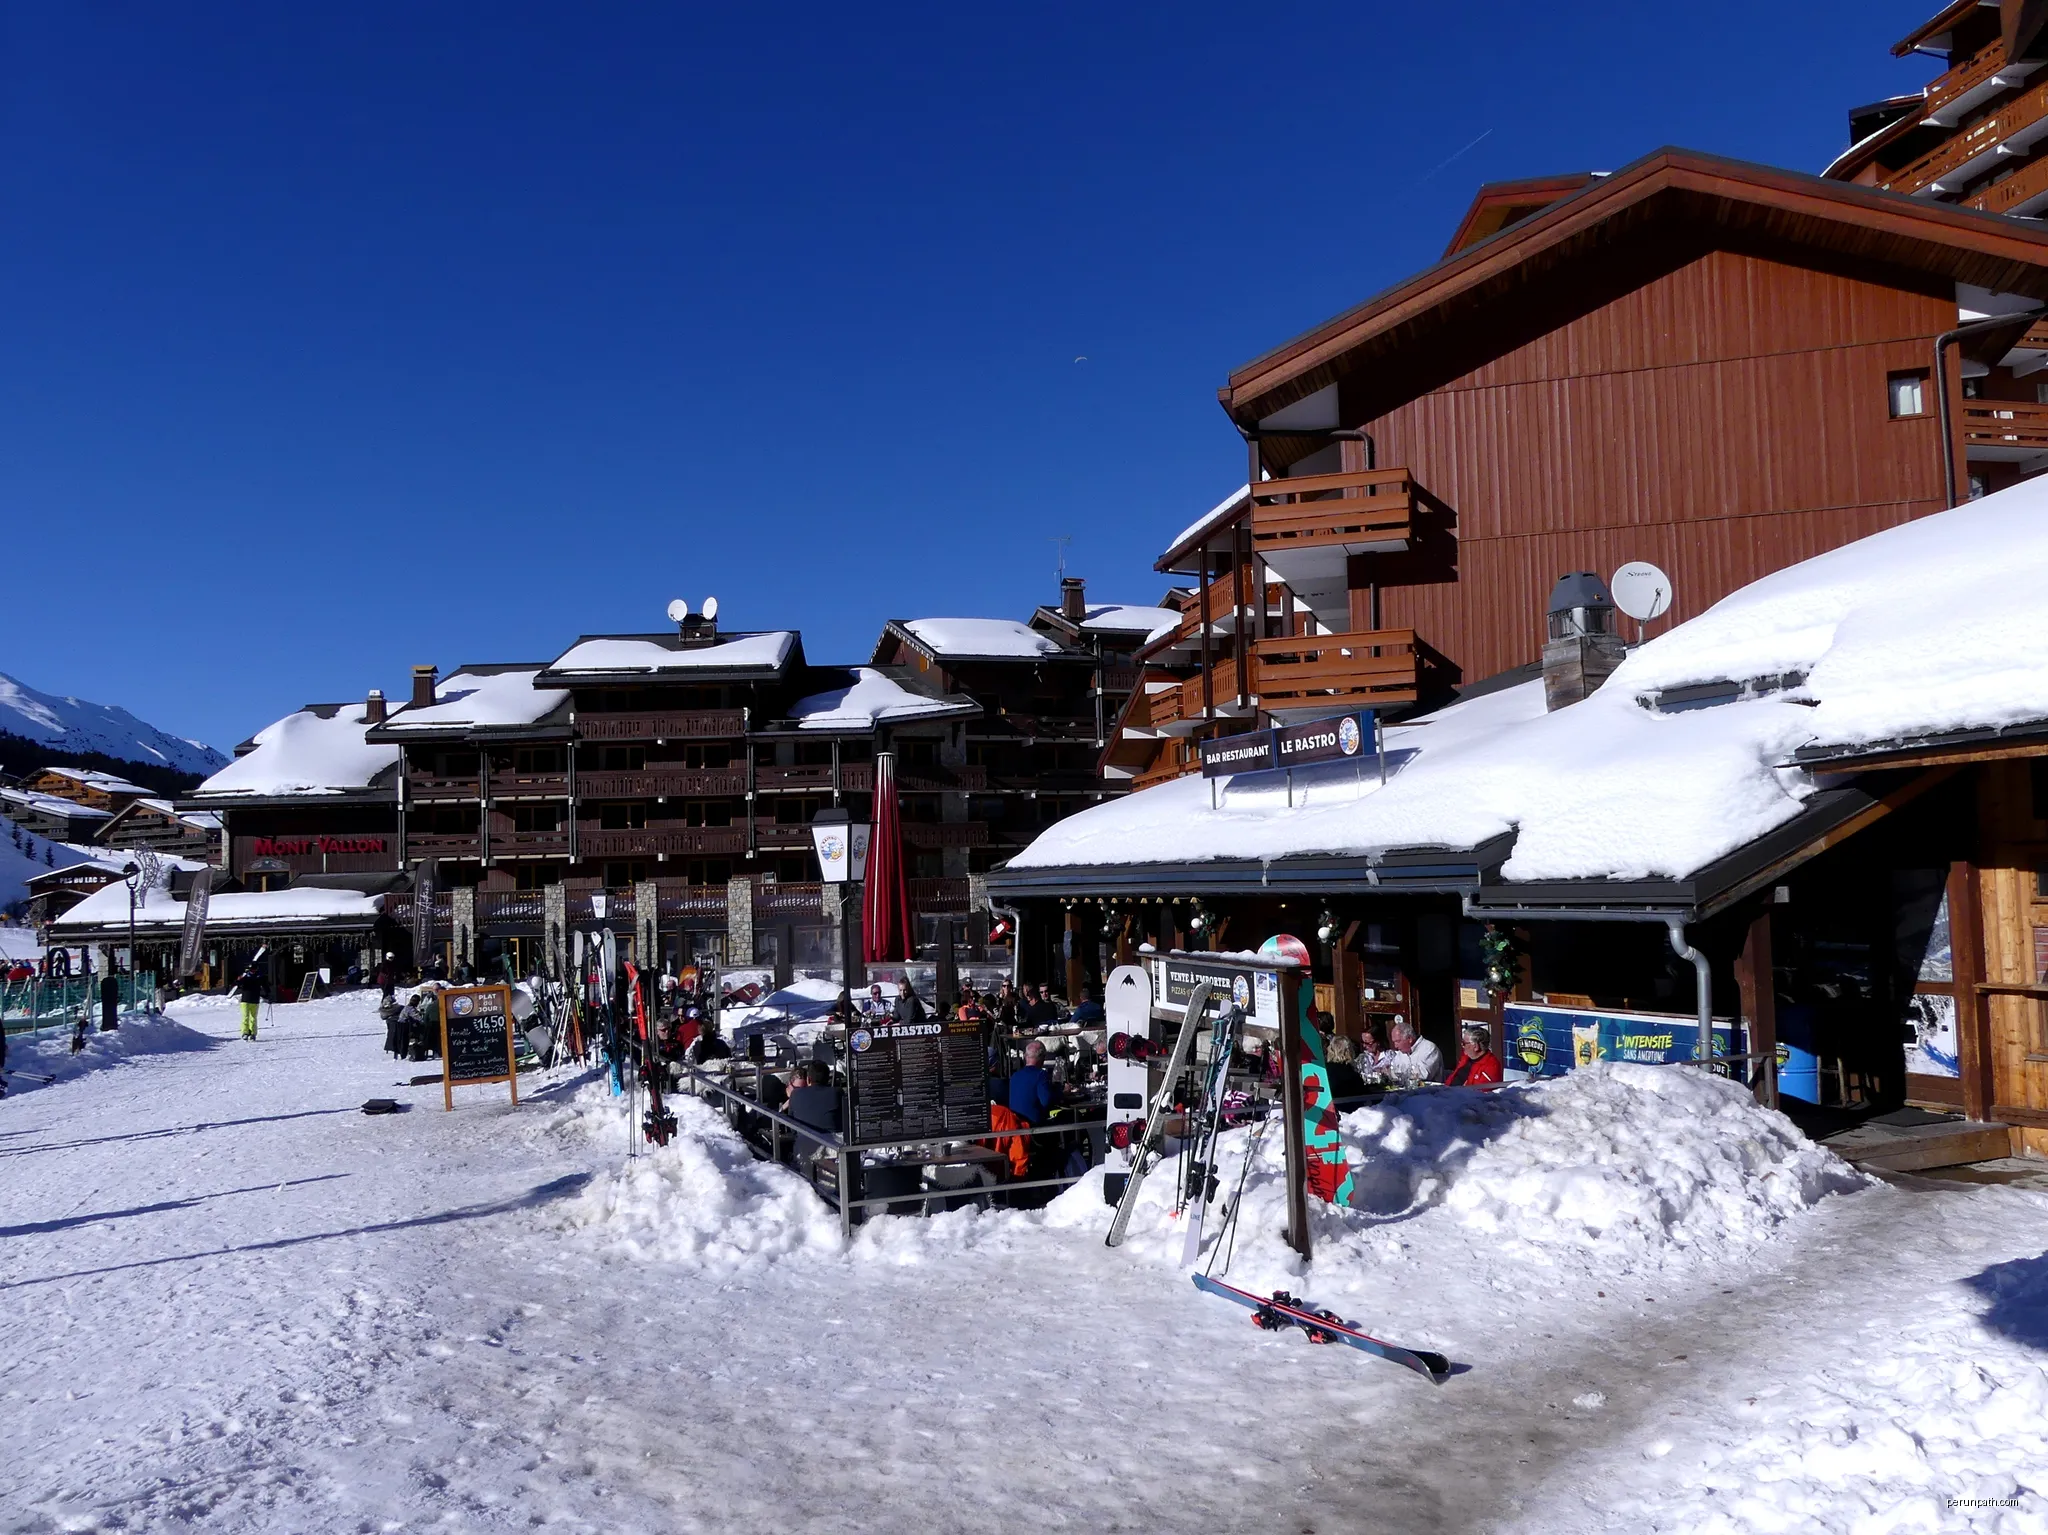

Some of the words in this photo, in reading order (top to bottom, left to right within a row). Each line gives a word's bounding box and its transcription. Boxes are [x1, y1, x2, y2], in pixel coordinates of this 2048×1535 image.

[1281, 741, 1293, 754] LE
[1295, 732, 1336, 751] RASTRO
[1206, 753, 1221, 764] BAR
[1222, 745, 1270, 762] RESTAURANT
[254, 838, 311, 855] MONT
[317, 836, 386, 853] VALLON
[185, 927, 197, 959] BRASSERIE
[1170, 971, 1190, 984] VENTE
[1190, 972, 1196, 984] À
[1171, 985, 1186, 996] PIZZAS
[873, 1028, 889, 1039] LE
[891, 1024, 942, 1037] RASTRO
[1615, 1031, 1673, 1049] L'INTENSITÉ
[1623, 1049, 1637, 1060] SANS
